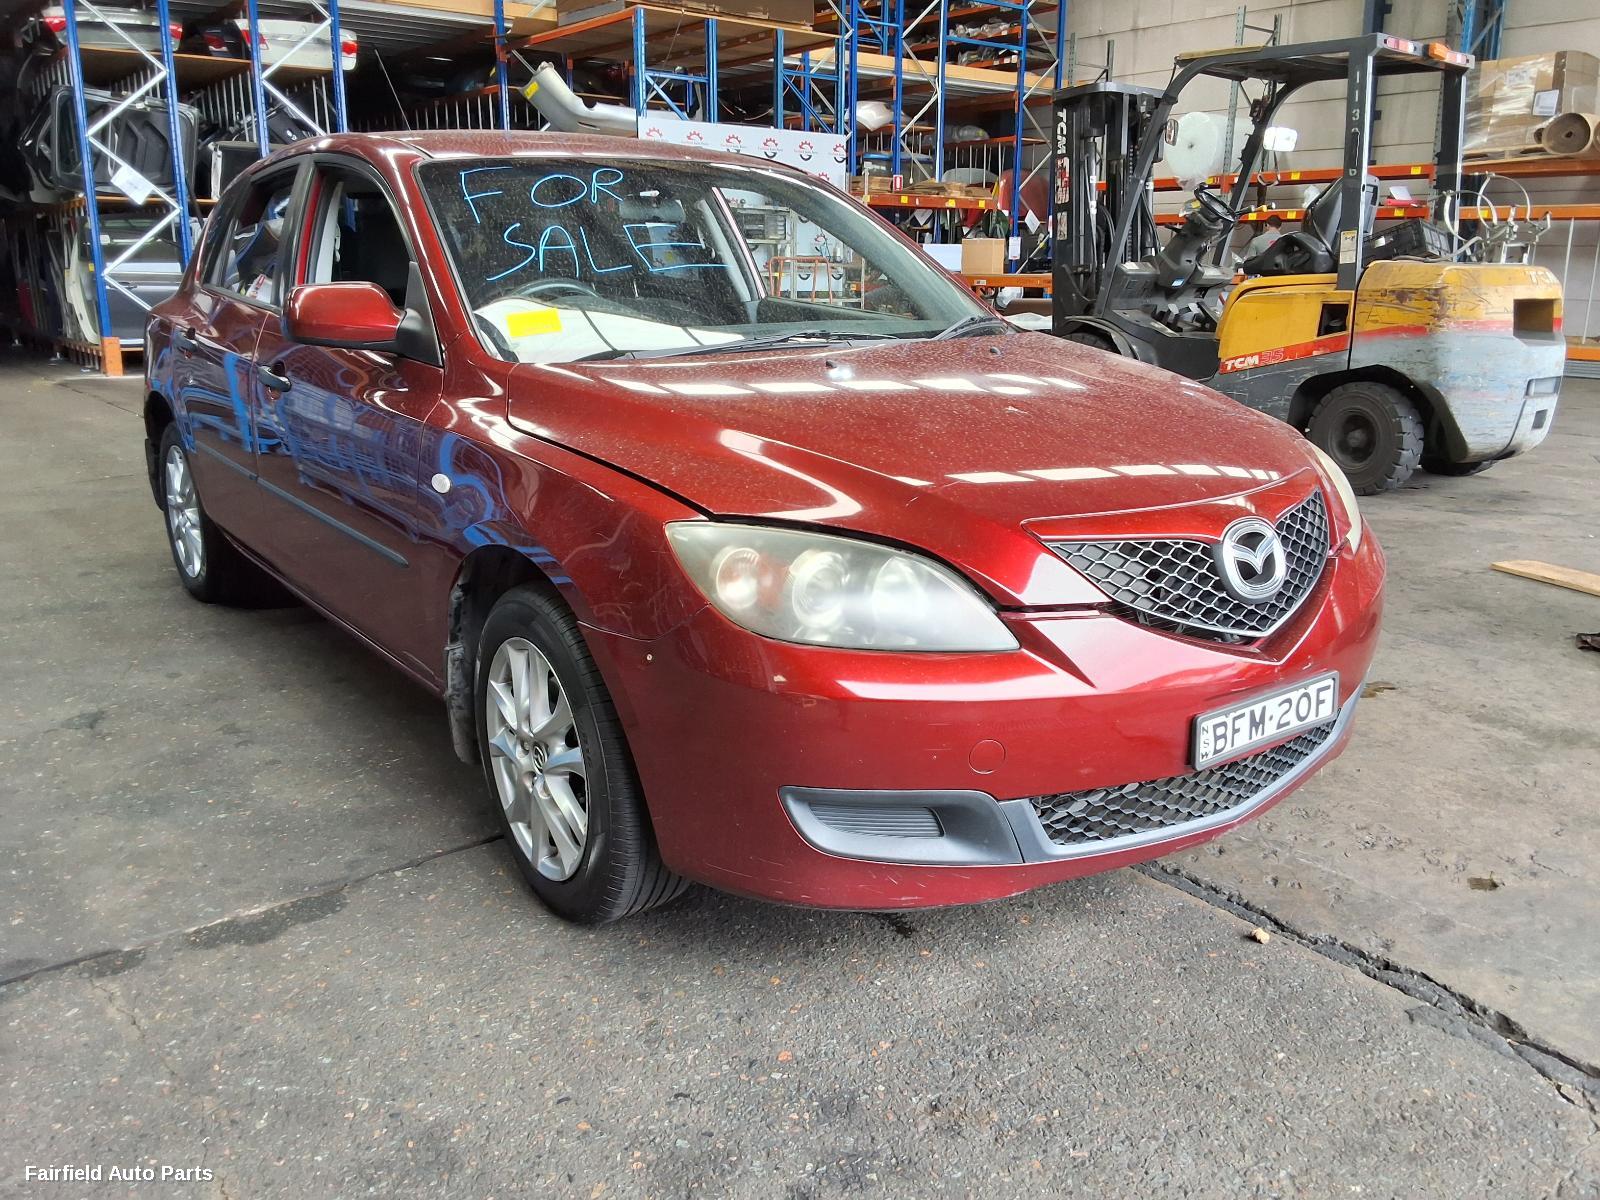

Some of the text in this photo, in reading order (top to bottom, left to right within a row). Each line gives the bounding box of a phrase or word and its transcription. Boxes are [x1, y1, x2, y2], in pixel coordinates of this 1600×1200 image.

[1056, 107, 1067, 155] TCM
[460, 166, 623, 224] FOR
[486, 222, 729, 281] SALE
[1225, 354, 1260, 371] TCM
[1201, 726, 1209, 760] NSW
